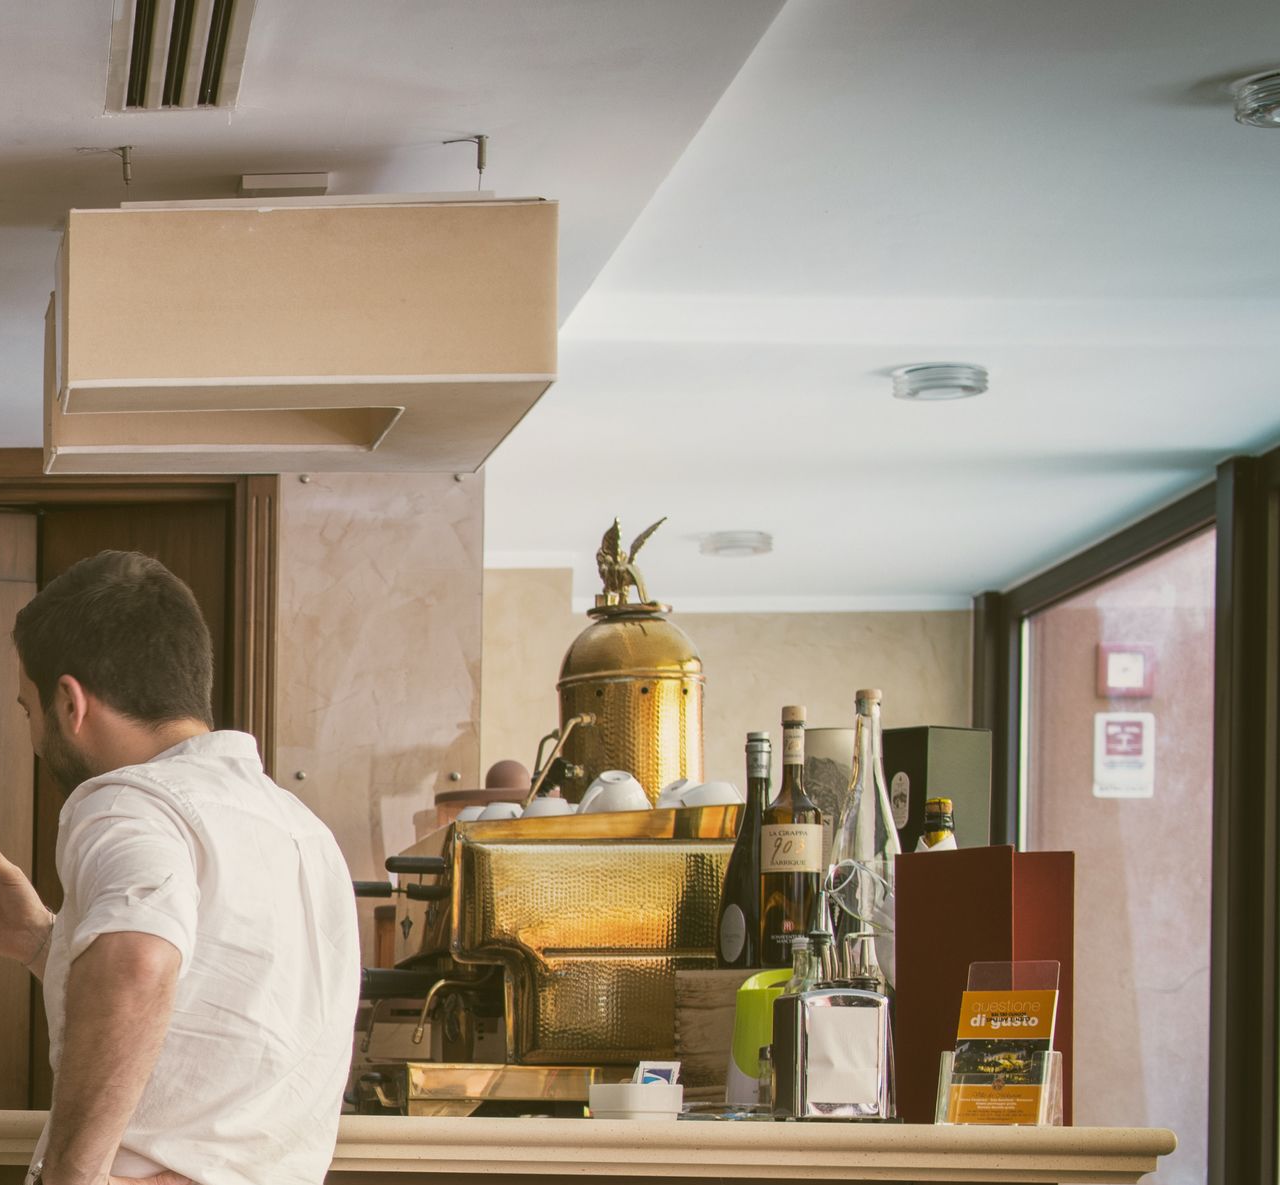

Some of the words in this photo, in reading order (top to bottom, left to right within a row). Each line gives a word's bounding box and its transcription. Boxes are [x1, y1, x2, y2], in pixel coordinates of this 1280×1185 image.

[972, 1000, 1041, 1013] questione
[970, 1014, 986, 1027] di
[991, 1015, 1039, 1029] gusto
